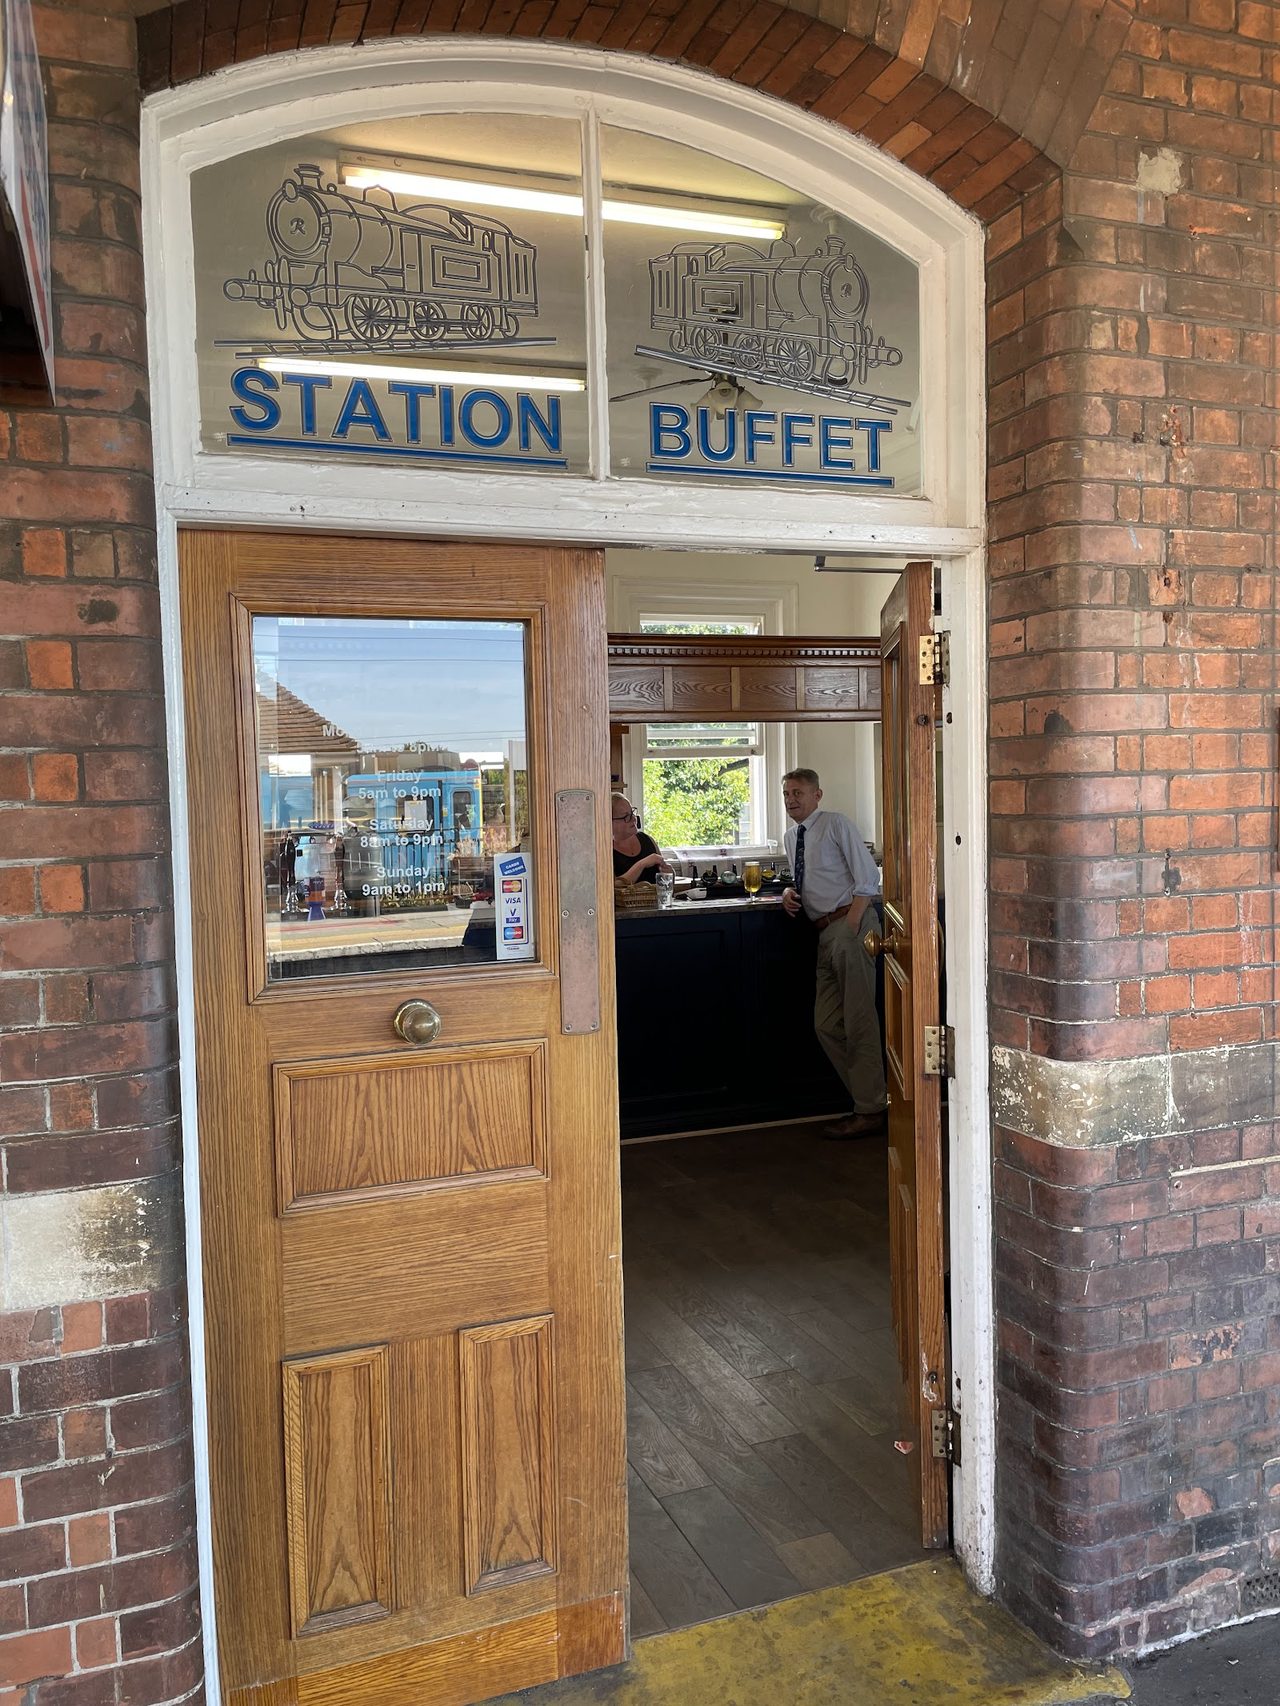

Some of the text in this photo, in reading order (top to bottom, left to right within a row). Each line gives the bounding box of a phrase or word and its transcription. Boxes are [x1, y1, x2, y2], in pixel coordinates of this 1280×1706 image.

[229, 366, 563, 454] STATION
[649, 402, 893, 474] BUFFET
[377, 770, 423, 784] Friday
[358, 785, 442, 801] 5am to 9pm
[369, 817, 434, 831] Saturday
[360, 833, 443, 848] 8am to 9pm
[376, 865, 431, 879] Sunday
[362, 881, 446, 896] 9am to 1pm
[509, 908, 517, 917] V
